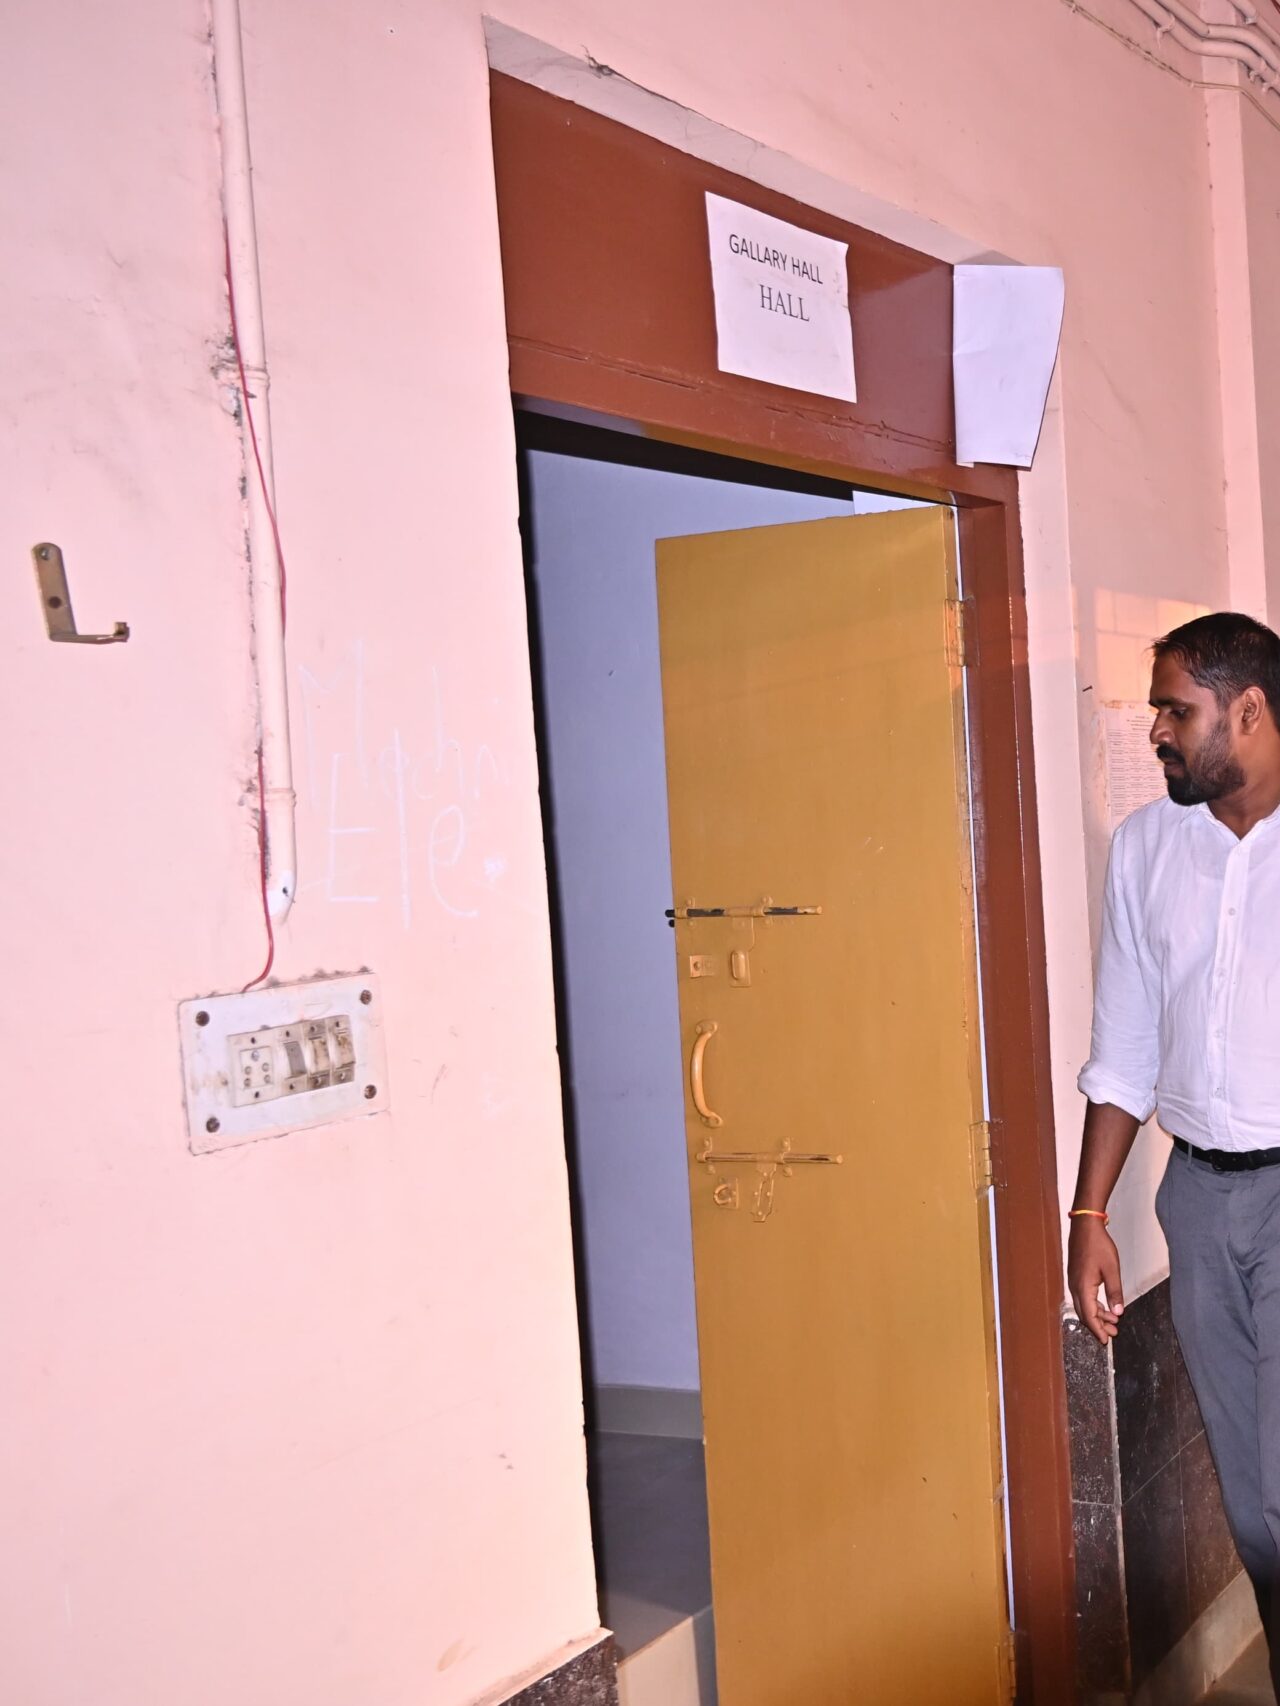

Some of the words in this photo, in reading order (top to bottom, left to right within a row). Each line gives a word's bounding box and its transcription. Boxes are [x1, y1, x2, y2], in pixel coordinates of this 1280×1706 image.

[729, 233, 787, 272] GALLARY
[791, 256, 823, 285] HALL
[759, 283, 810, 322] HALL
